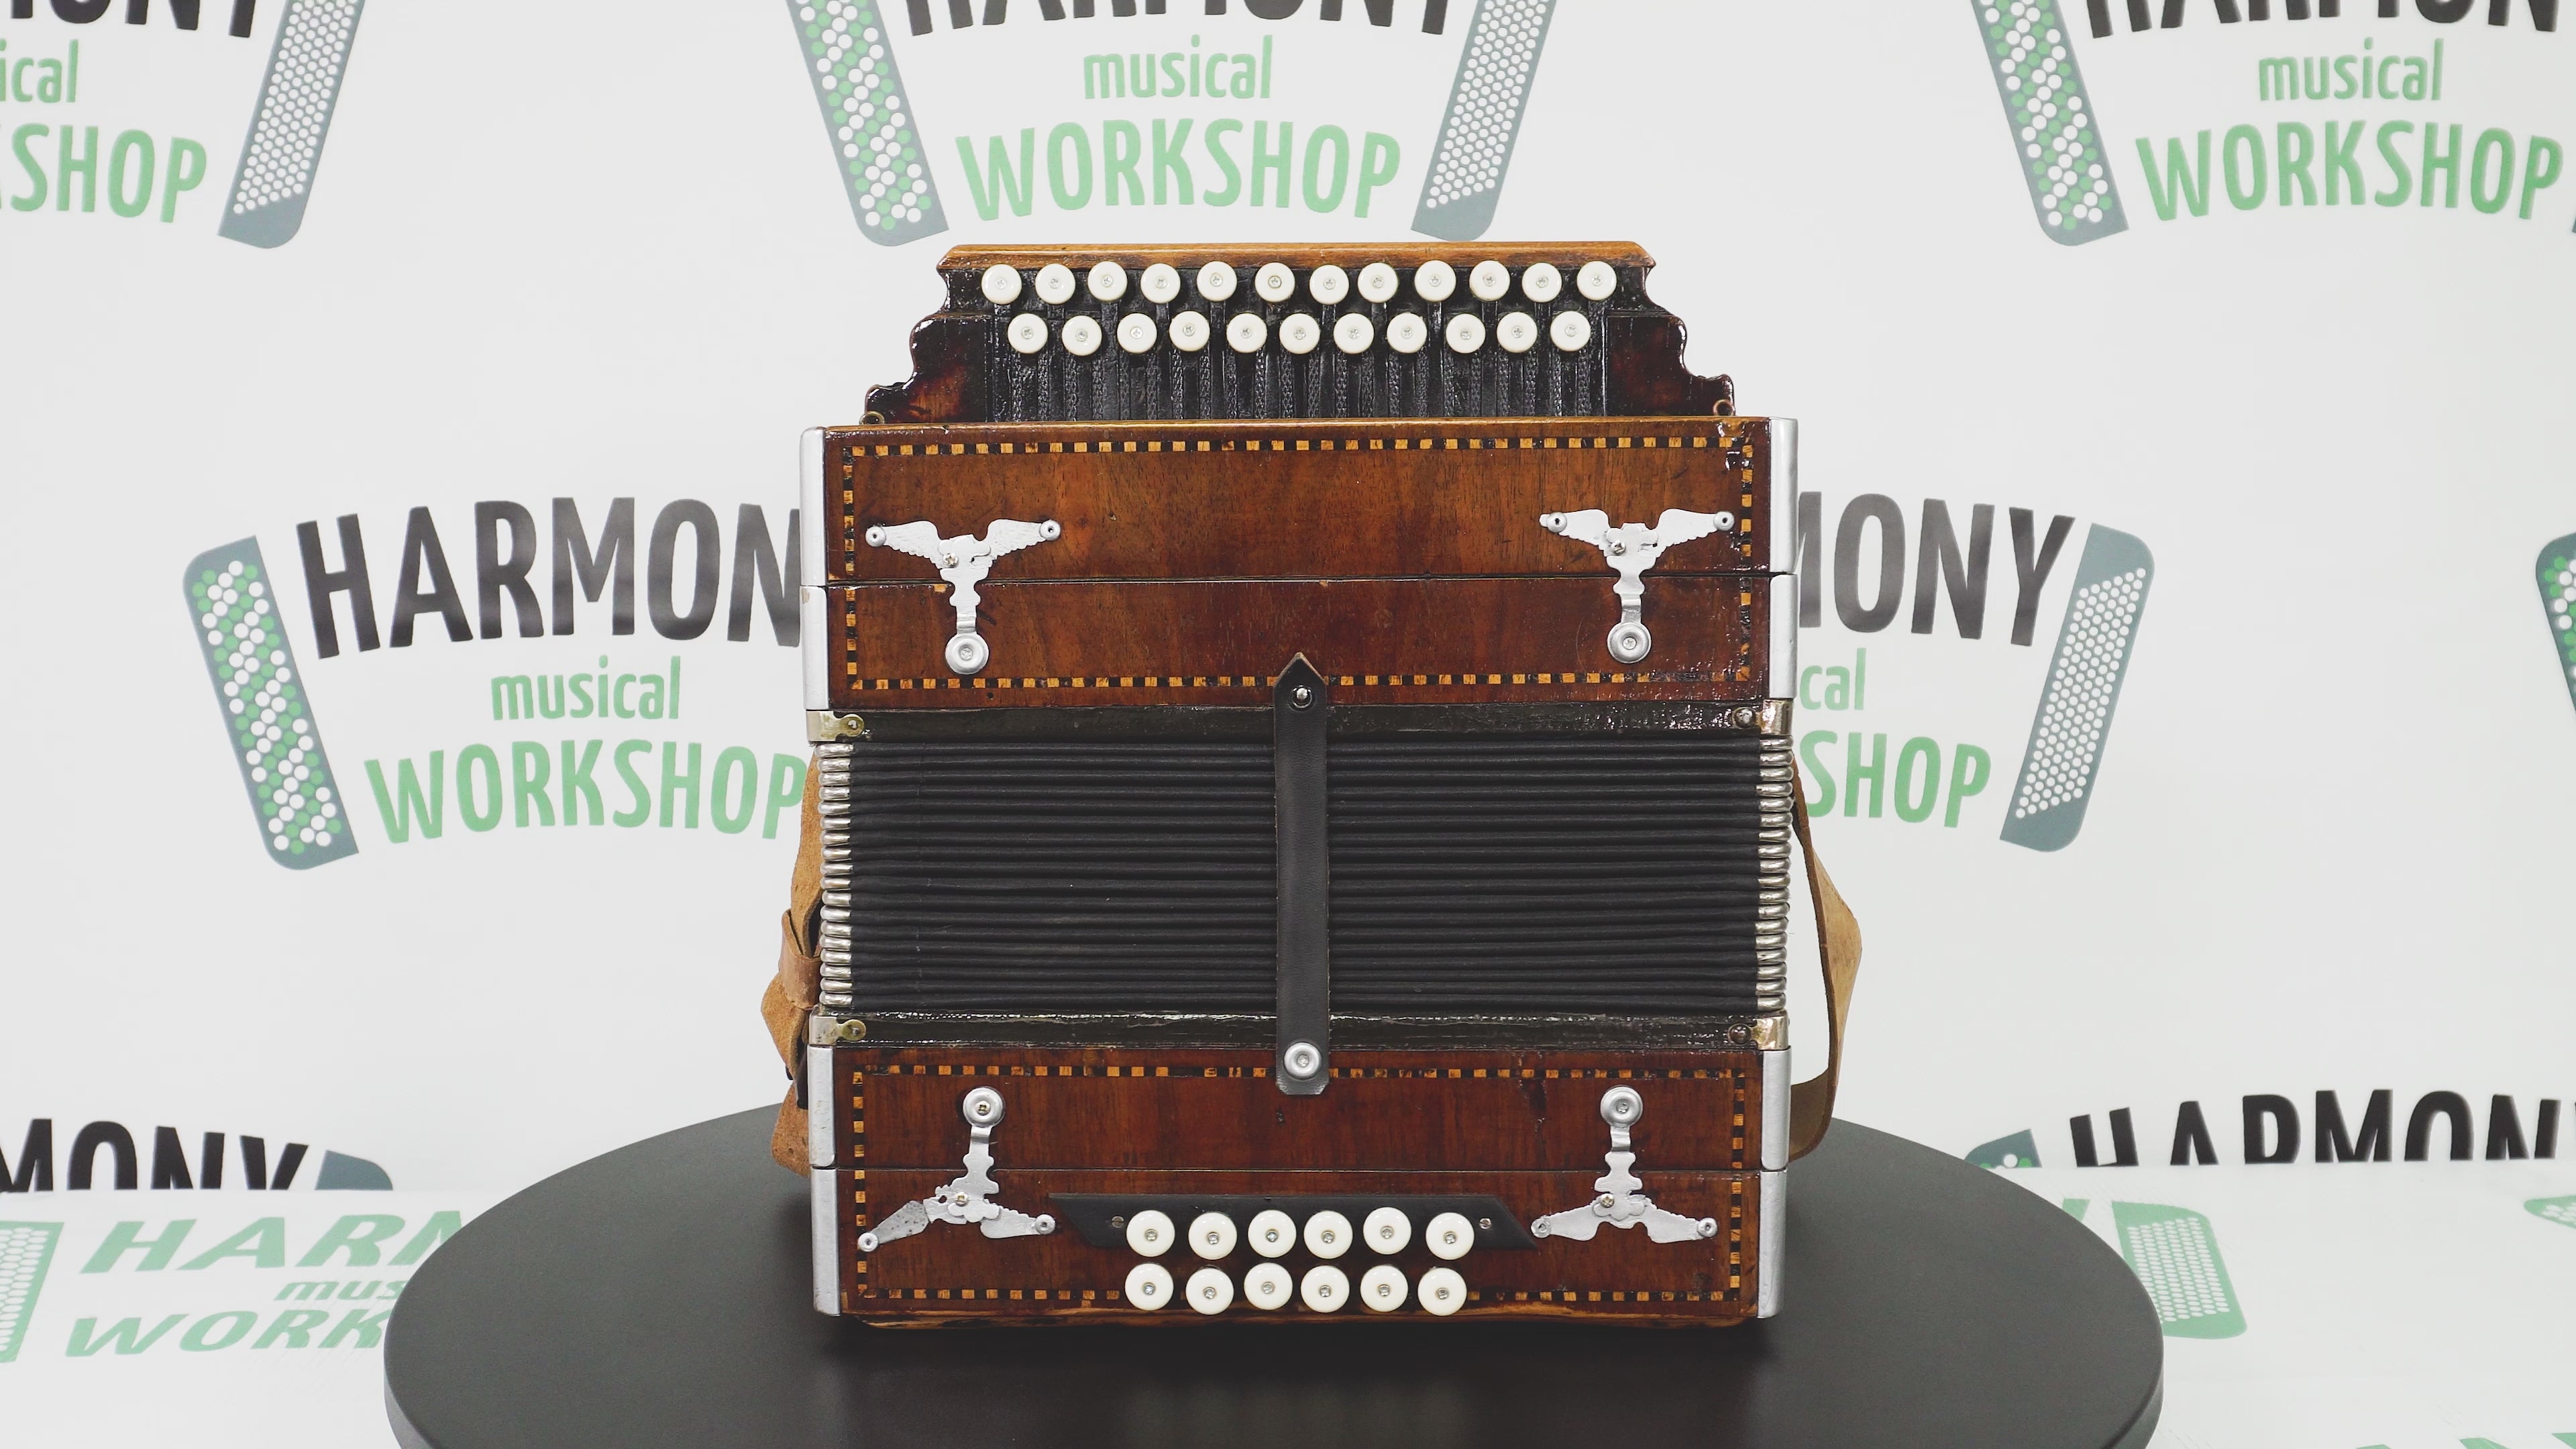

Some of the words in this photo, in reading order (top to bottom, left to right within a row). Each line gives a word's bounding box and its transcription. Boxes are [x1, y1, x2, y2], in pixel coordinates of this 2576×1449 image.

[1084, 35, 1272, 99] musical
[2259, 38, 2443, 101] musical
[955, 119, 1399, 221] WORKSHOP
[2136, 120, 2563, 221] WORKSHOP
[1799, 492, 2074, 646] ONY
[490, 655, 680, 720] musical
[364, 739, 806, 843] WORKSHOP
